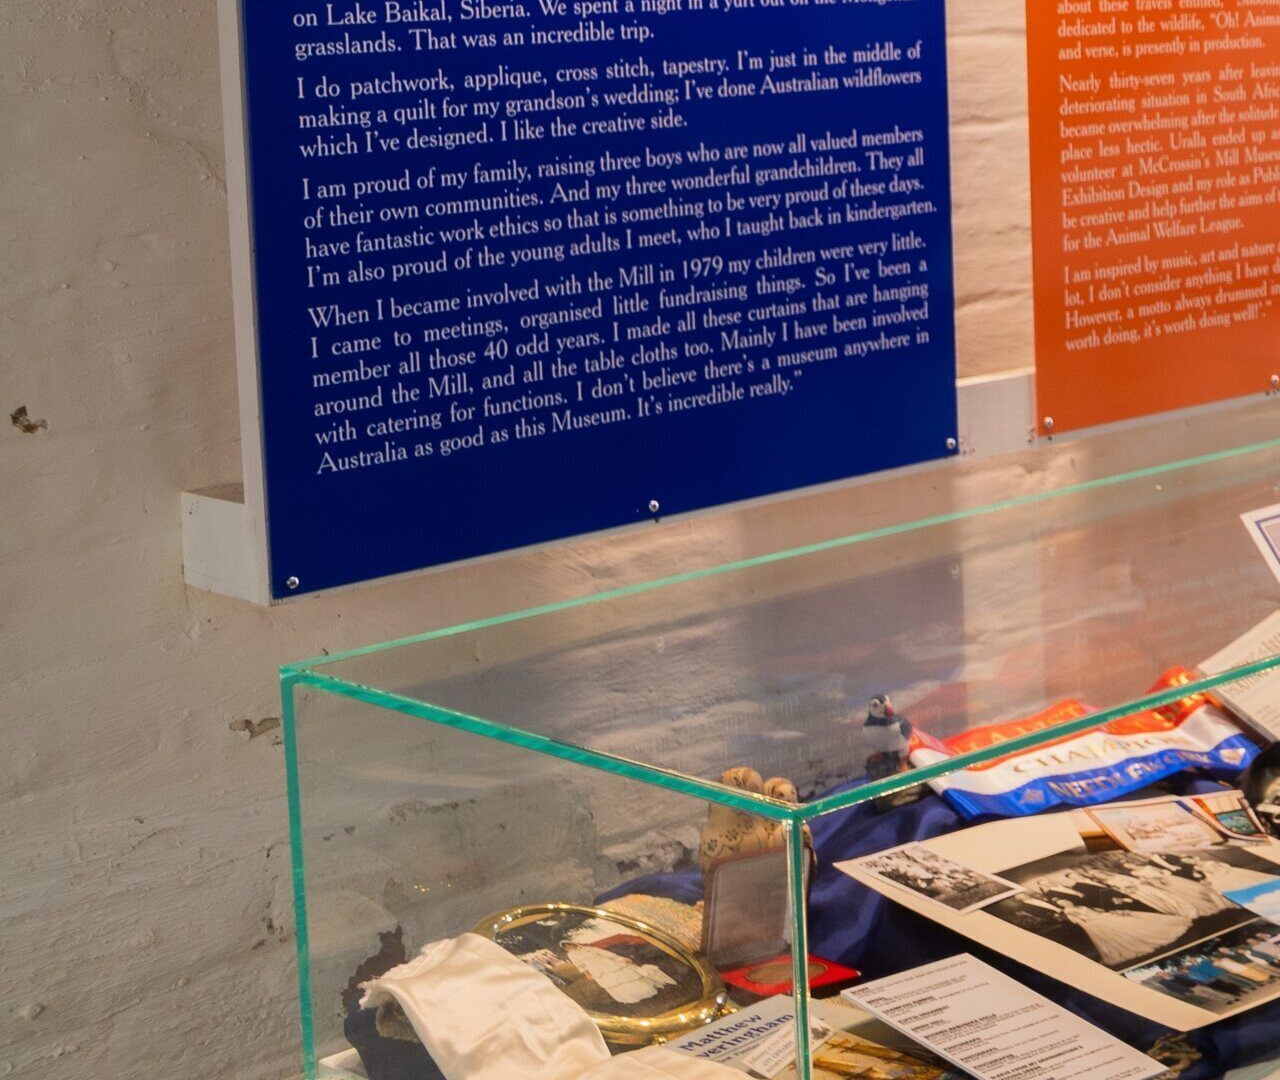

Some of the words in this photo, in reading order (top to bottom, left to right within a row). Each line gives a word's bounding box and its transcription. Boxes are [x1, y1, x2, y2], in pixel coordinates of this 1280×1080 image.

[294, 30, 402, 61] grasslands.
[407, 27, 456, 50] That
[461, 33, 497, 47] was
[502, 32, 524, 46] an
[530, 19, 614, 44] incredible
[620, 19, 654, 43] trip.
[307, 303, 369, 328] When
[376, 298, 383, 320] I
[389, 296, 460, 318] became
[466, 278, 539, 308] involved
[544, 273, 582, 297] with
[587, 270, 613, 292] the
[618, 263, 654, 287] Mill
[659, 263, 675, 282] in
[682, 255, 723, 278] 1979
[727, 258, 751, 275] my
[754, 245, 816, 269] children
[819, 245, 854, 260] were
[856, 241, 888, 256] very
[891, 230, 926, 251] little.
[316, 440, 408, 475] Australia
[413, 441, 433, 457] as
[439, 424, 484, 456] good
[490, 428, 509, 443] as
[514, 416, 546, 439] this
[551, 408, 631, 433] Museum.
[637, 394, 663, 417] It’s
[667, 381, 744, 412] incredible
[749, 369, 802, 397] really.”
[679, 1014, 762, 1051] Matthew
[694, 1013, 795, 1059] veringham
